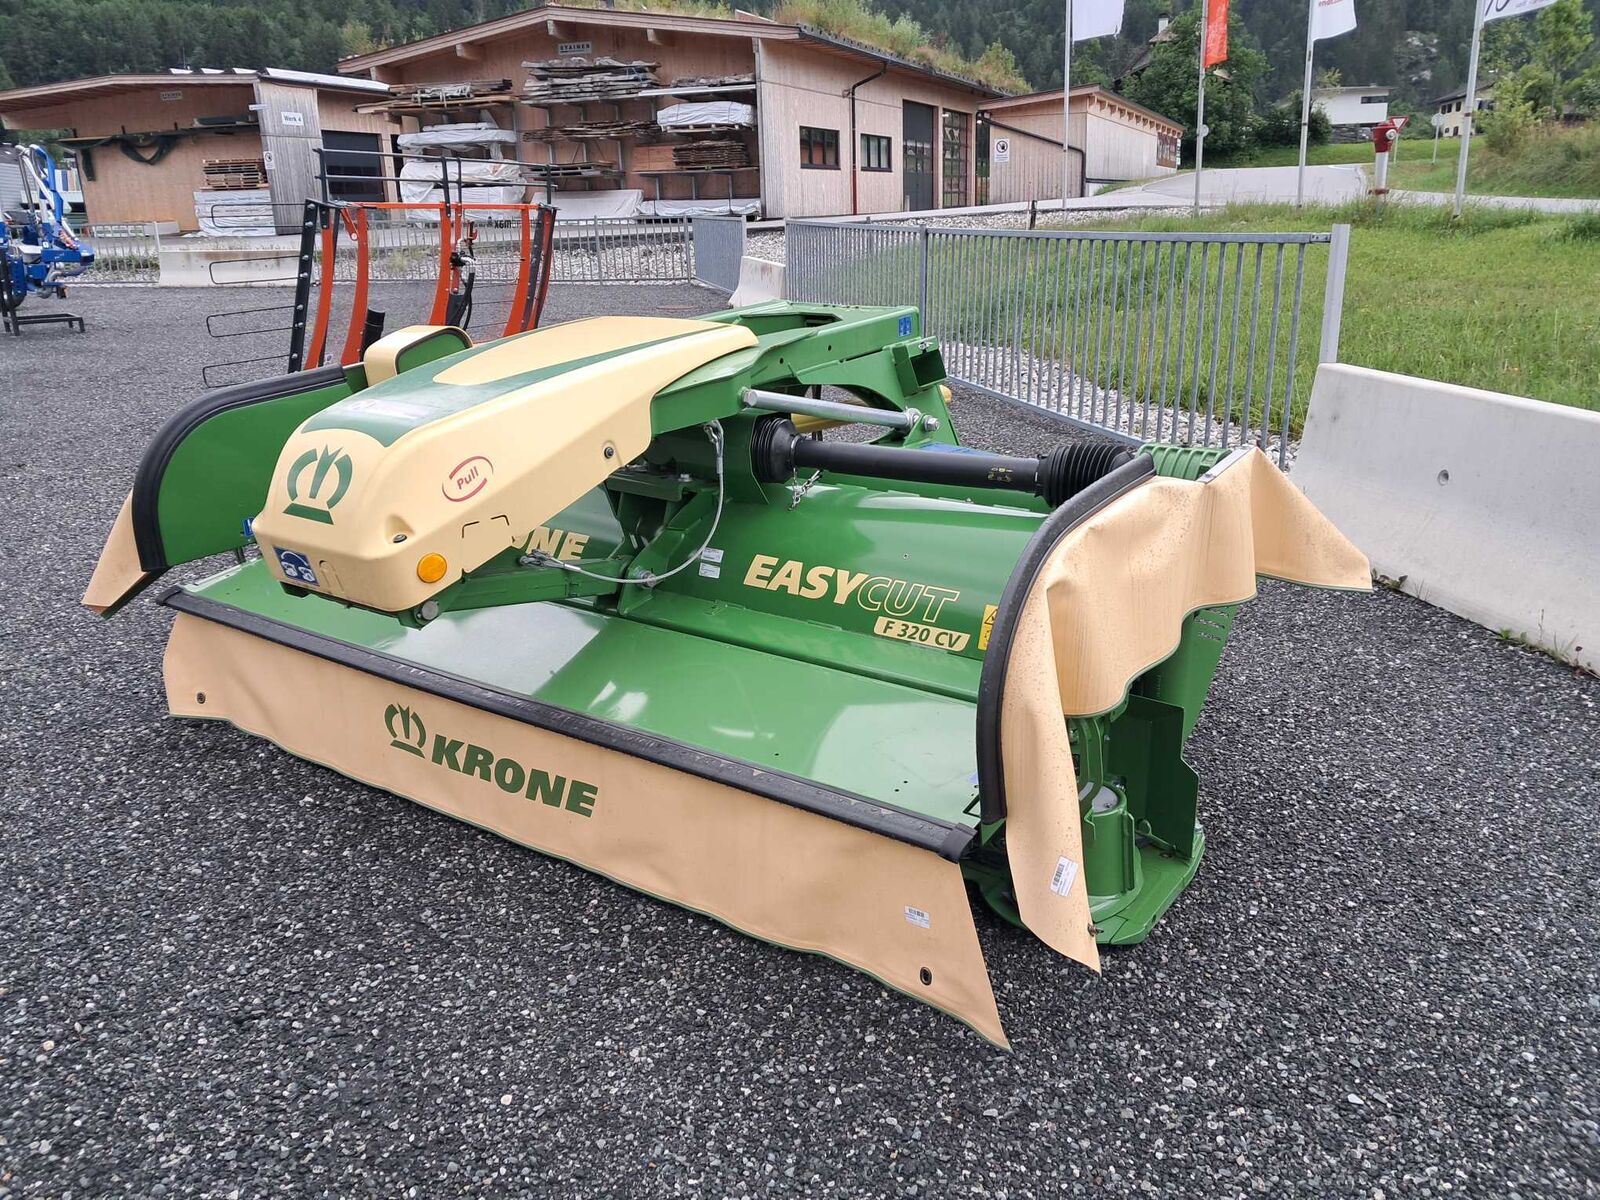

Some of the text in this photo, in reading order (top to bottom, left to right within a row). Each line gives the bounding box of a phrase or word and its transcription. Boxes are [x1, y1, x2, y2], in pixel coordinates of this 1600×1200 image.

[456, 465, 479, 490] Pull
[743, 554, 960, 623] EASYCUT
[883, 620, 962, 649] F 320 CV
[431, 733, 598, 818] KRONE
